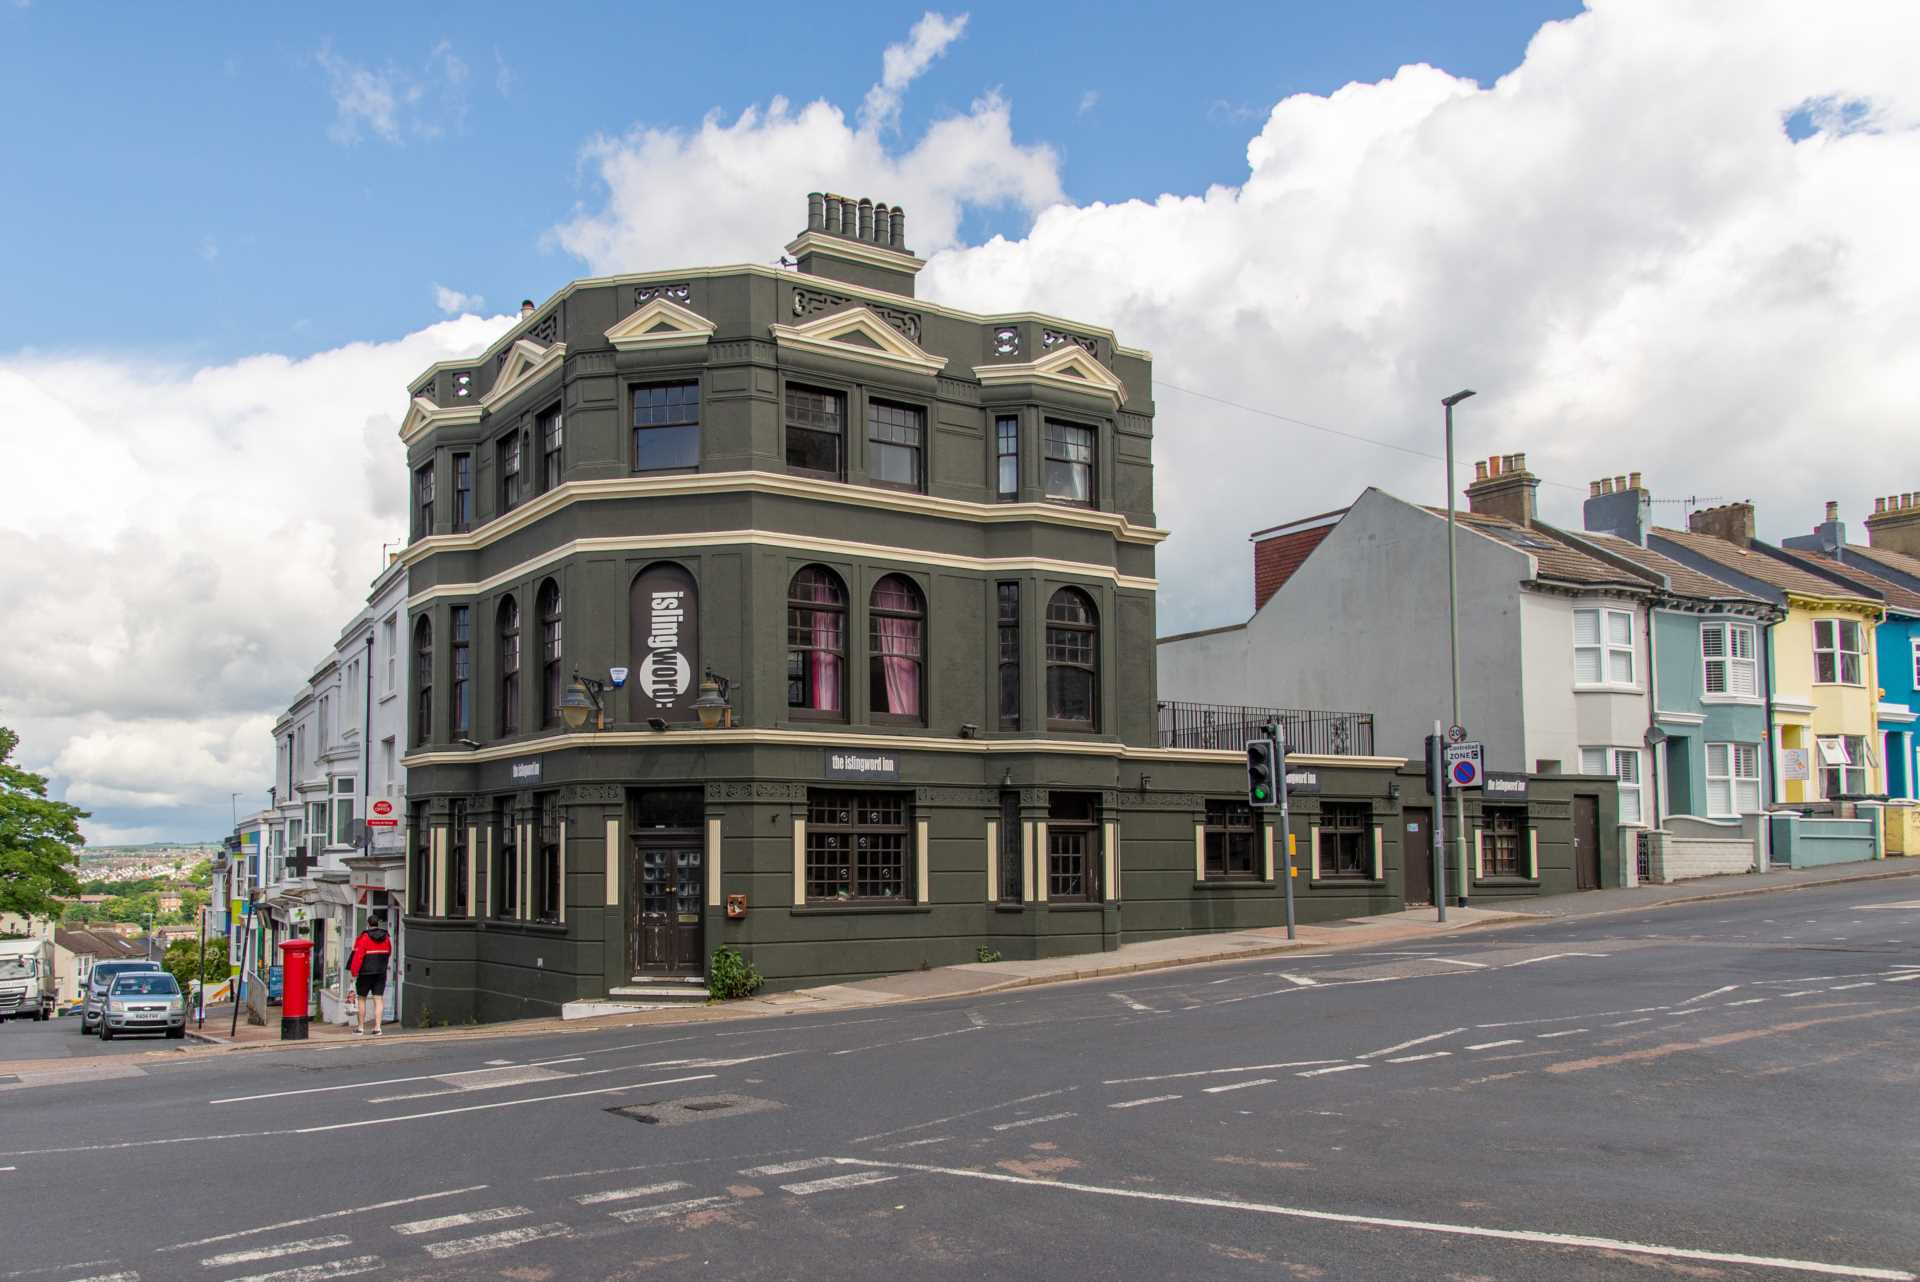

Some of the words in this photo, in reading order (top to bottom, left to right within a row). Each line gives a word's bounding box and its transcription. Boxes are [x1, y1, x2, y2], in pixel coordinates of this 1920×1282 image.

[1449, 752, 1470, 760] ZONE
[832, 754, 844, 770] the
[845, 755, 881, 772] islingword
[882, 757, 894, 772] inn
